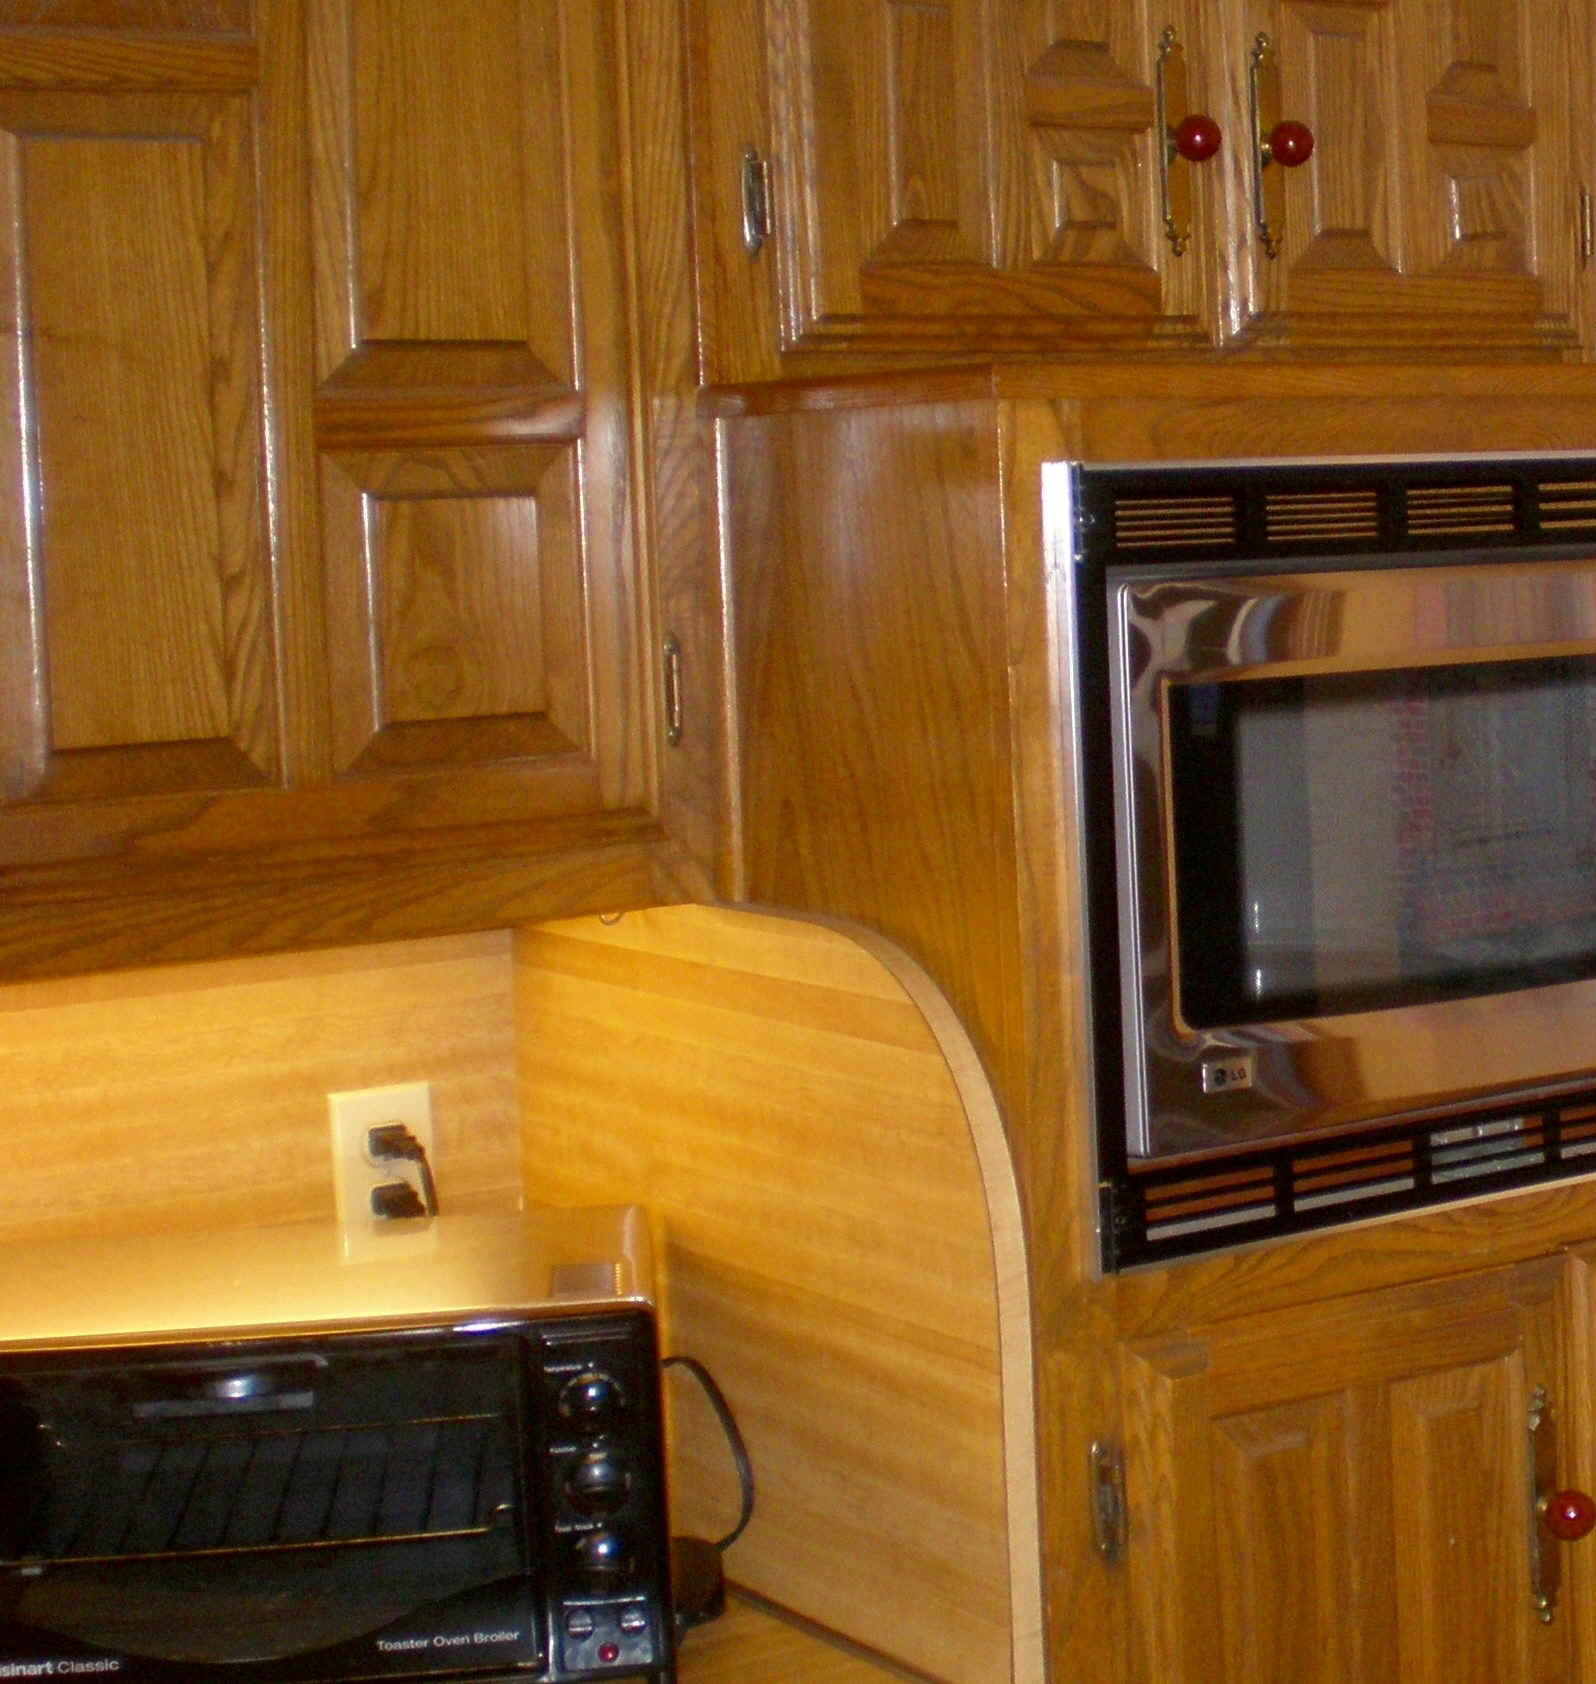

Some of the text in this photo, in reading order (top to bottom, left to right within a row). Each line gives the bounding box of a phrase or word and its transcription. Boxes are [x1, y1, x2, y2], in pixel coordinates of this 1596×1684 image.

[377, 1631, 520, 1651] Toaster Oven Broiler
[57, 1659, 120, 1674] Classic
